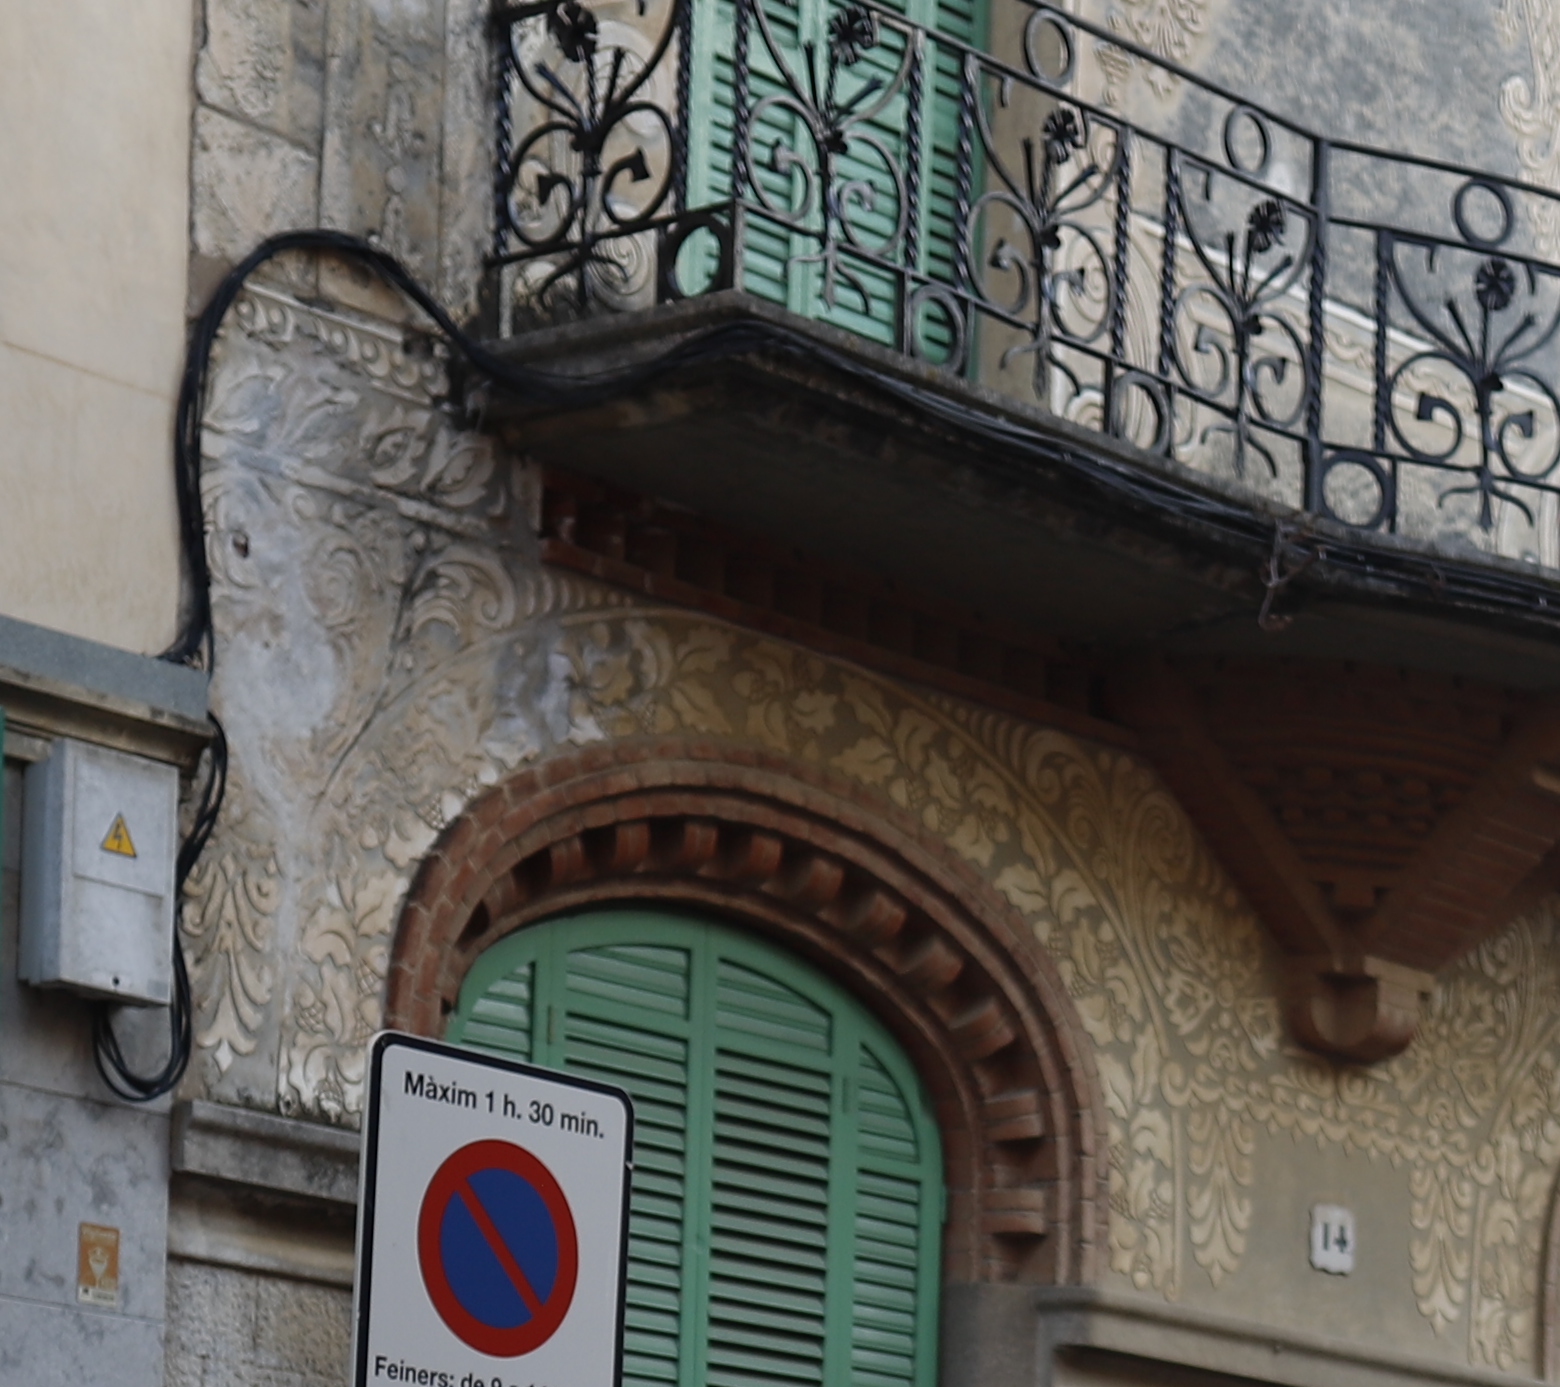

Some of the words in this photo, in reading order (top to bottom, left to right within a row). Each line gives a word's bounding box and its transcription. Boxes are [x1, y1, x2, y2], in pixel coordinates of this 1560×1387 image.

[404, 1070, 478, 1110] Màxim
[485, 1090, 495, 1114] 1
[503, 1093, 522, 1120] h.
[528, 1099, 555, 1127] 30
[560, 1111, 604, 1139] min.
[1322, 1221, 1349, 1253] 14
